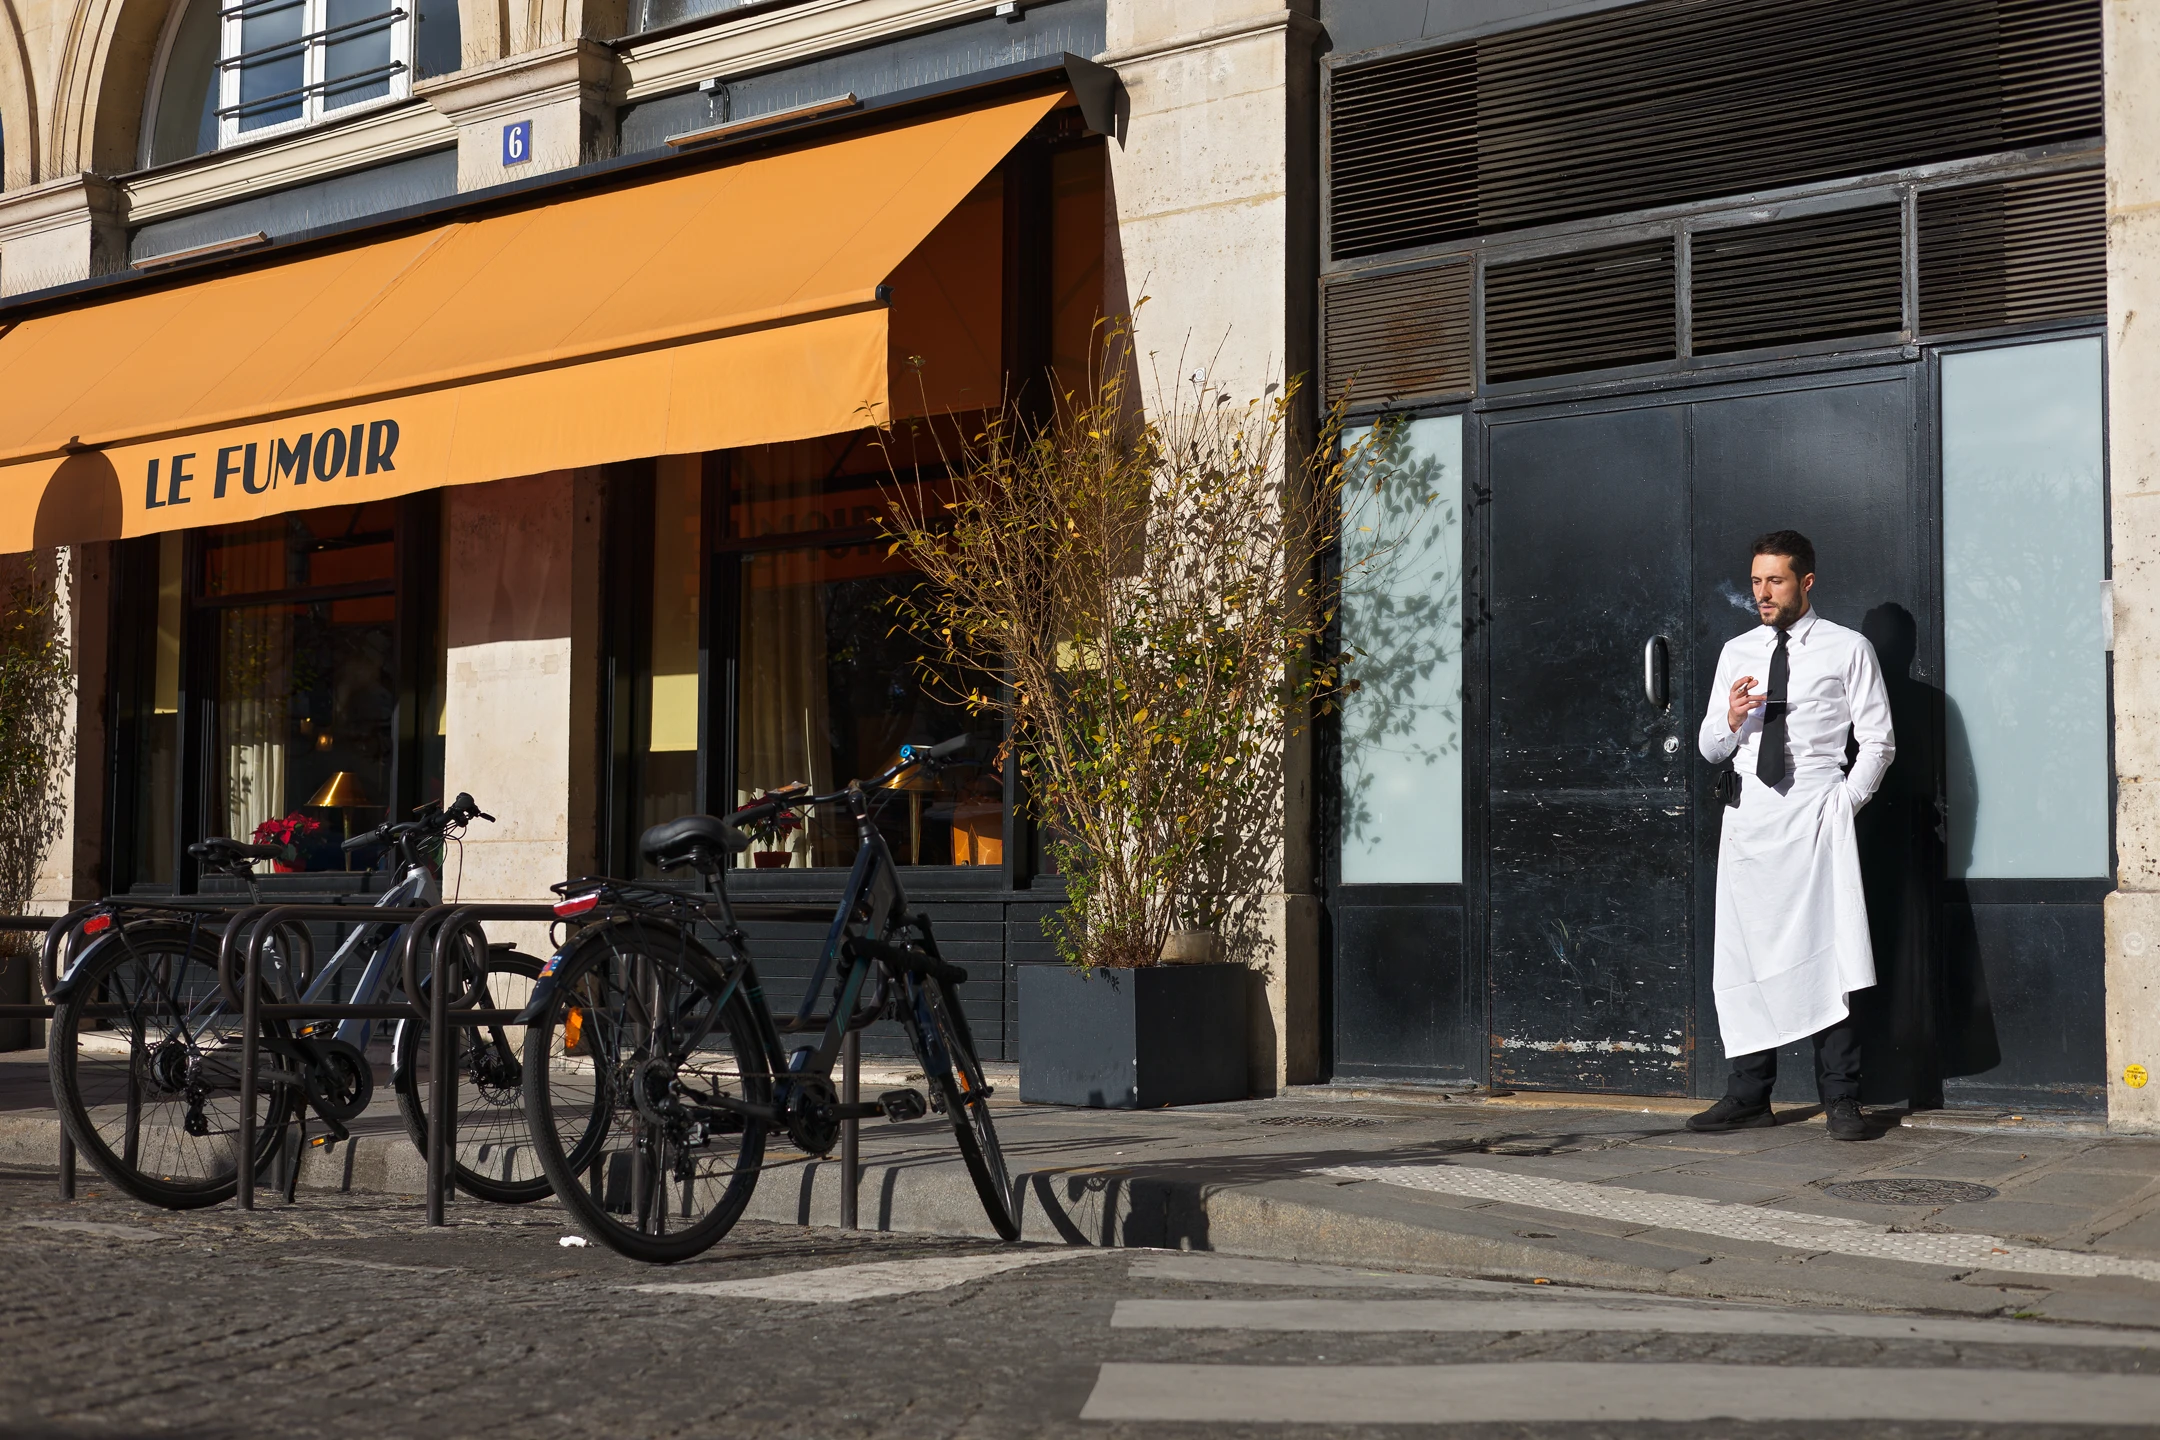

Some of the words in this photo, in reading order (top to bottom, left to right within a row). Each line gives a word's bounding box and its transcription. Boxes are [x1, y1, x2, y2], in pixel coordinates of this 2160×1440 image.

[509, 127, 522, 158] 6
[145, 453, 196, 510] LE
[213, 419, 400, 499] FUMOIR
